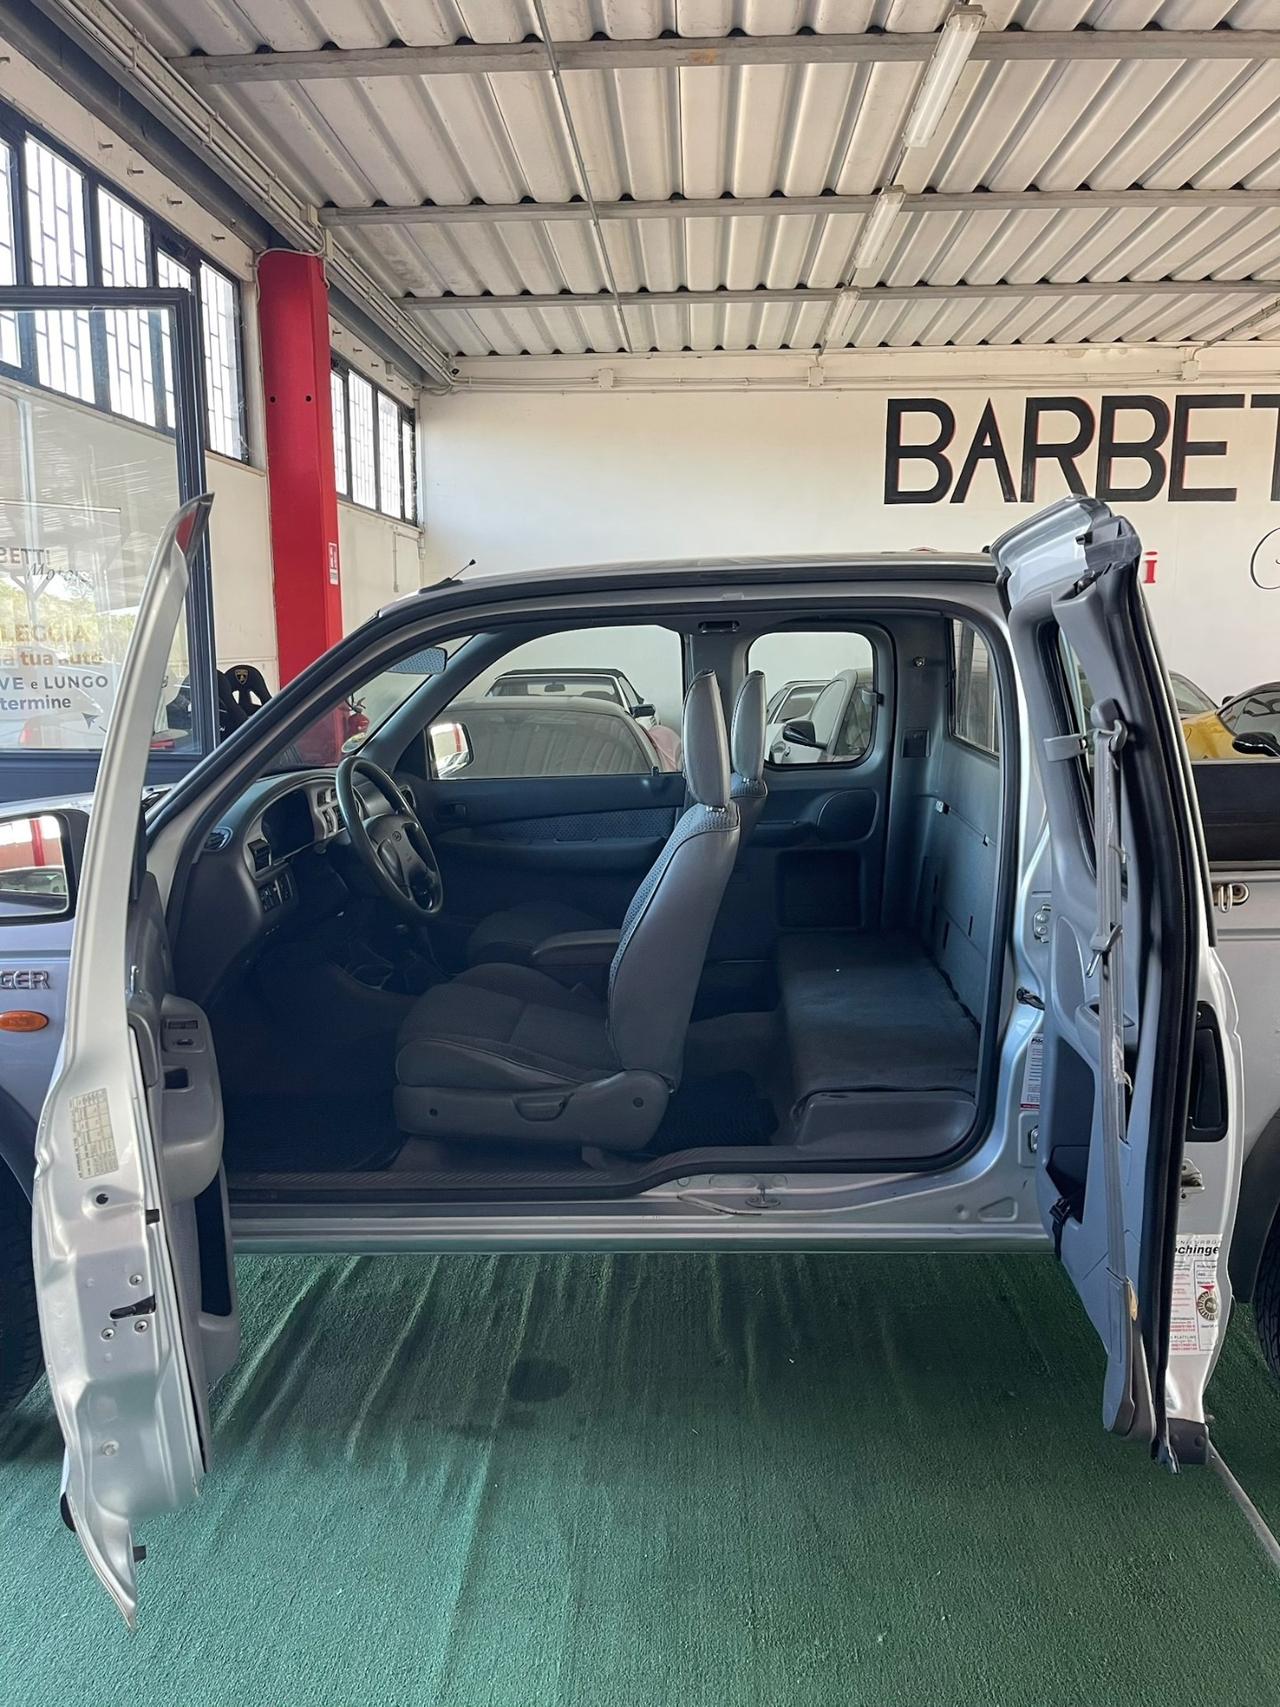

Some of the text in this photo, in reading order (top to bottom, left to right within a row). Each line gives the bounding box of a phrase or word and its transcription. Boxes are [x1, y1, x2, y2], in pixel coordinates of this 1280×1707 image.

[20, 651, 54, 666] tua
[31, 680, 39, 689] e
[44, 675, 108, 689] LUNGO
[0, 694, 71, 710] termine
